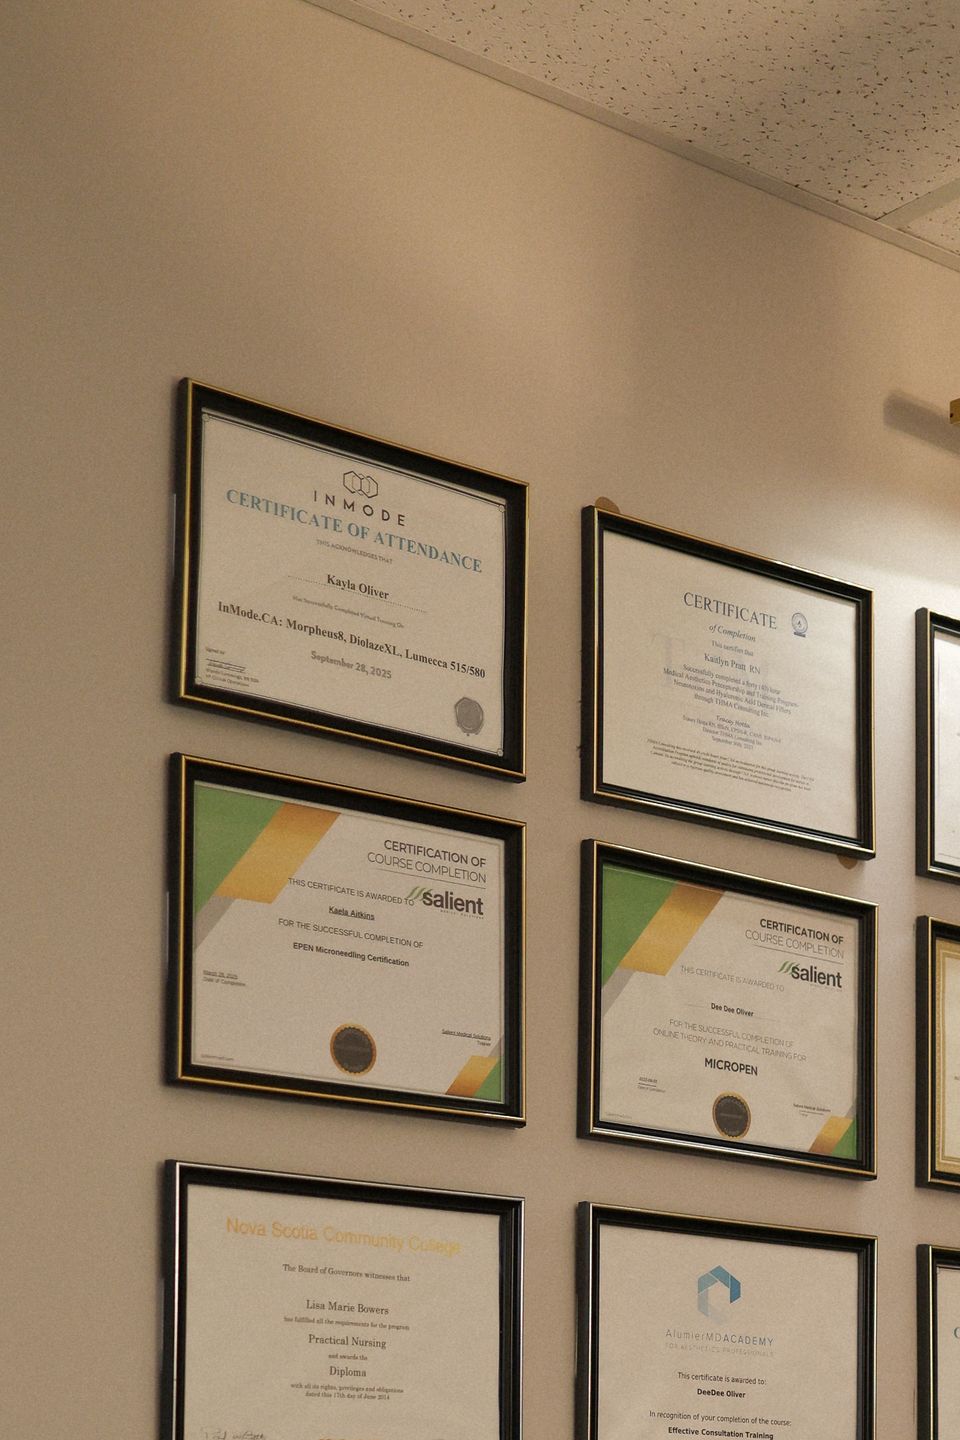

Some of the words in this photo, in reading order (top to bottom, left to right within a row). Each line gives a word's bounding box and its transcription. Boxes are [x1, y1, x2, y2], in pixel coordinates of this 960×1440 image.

[313, 490, 405, 527] INMODE
[226, 489, 343, 533] CERTIFICATE
[347, 522, 370, 540] OF
[373, 531, 482, 573] ATTENDANCE
[327, 574, 356, 591] Kayla
[358, 583, 389, 600] Oliver
[683, 592, 777, 630] CERTIFICATE
[218, 601, 283, 627] InMode.CA:
[286, 618, 347, 643] Morpheus8,
[349, 633, 403, 658] DiolazeXL,
[405, 648, 448, 669] Lumecca
[450, 660, 486, 678] 515/580
[749, 664, 761, 675] RN
[383, 839, 468, 865] CERTIFICATION
[470, 856, 486, 868] OF
[366, 851, 413, 871] COURSE
[414, 860, 487, 884] COMPLETION
[421, 888, 484, 916] salient
[744, 928, 784, 947] COURSE
[785, 937, 844, 959] COMPLETION
[759, 918, 830, 942] CERTIFICATION
[830, 934, 844, 945] OF
[790, 963, 842, 989] salient
[704, 1057, 758, 1076] MICROPEN
[226, 1216, 266, 1237] Nova
[323, 1225, 405, 1253] Community
[306, 1299, 326, 1310] Lisa
[328, 1300, 355, 1312] Marie
[357, 1303, 389, 1315] Bowers
[308, 1333, 349, 1346] Practical
[351, 1336, 387, 1350] Nursing
[329, 1365, 367, 1378] Diploma
[697, 1388, 725, 1397] DeeDee
[725, 1389, 746, 1398] Oliver
[668, 1426, 700, 1436] Effective
[700, 1428, 744, 1438] Consultation
[744, 1431, 774, 1440] Training
